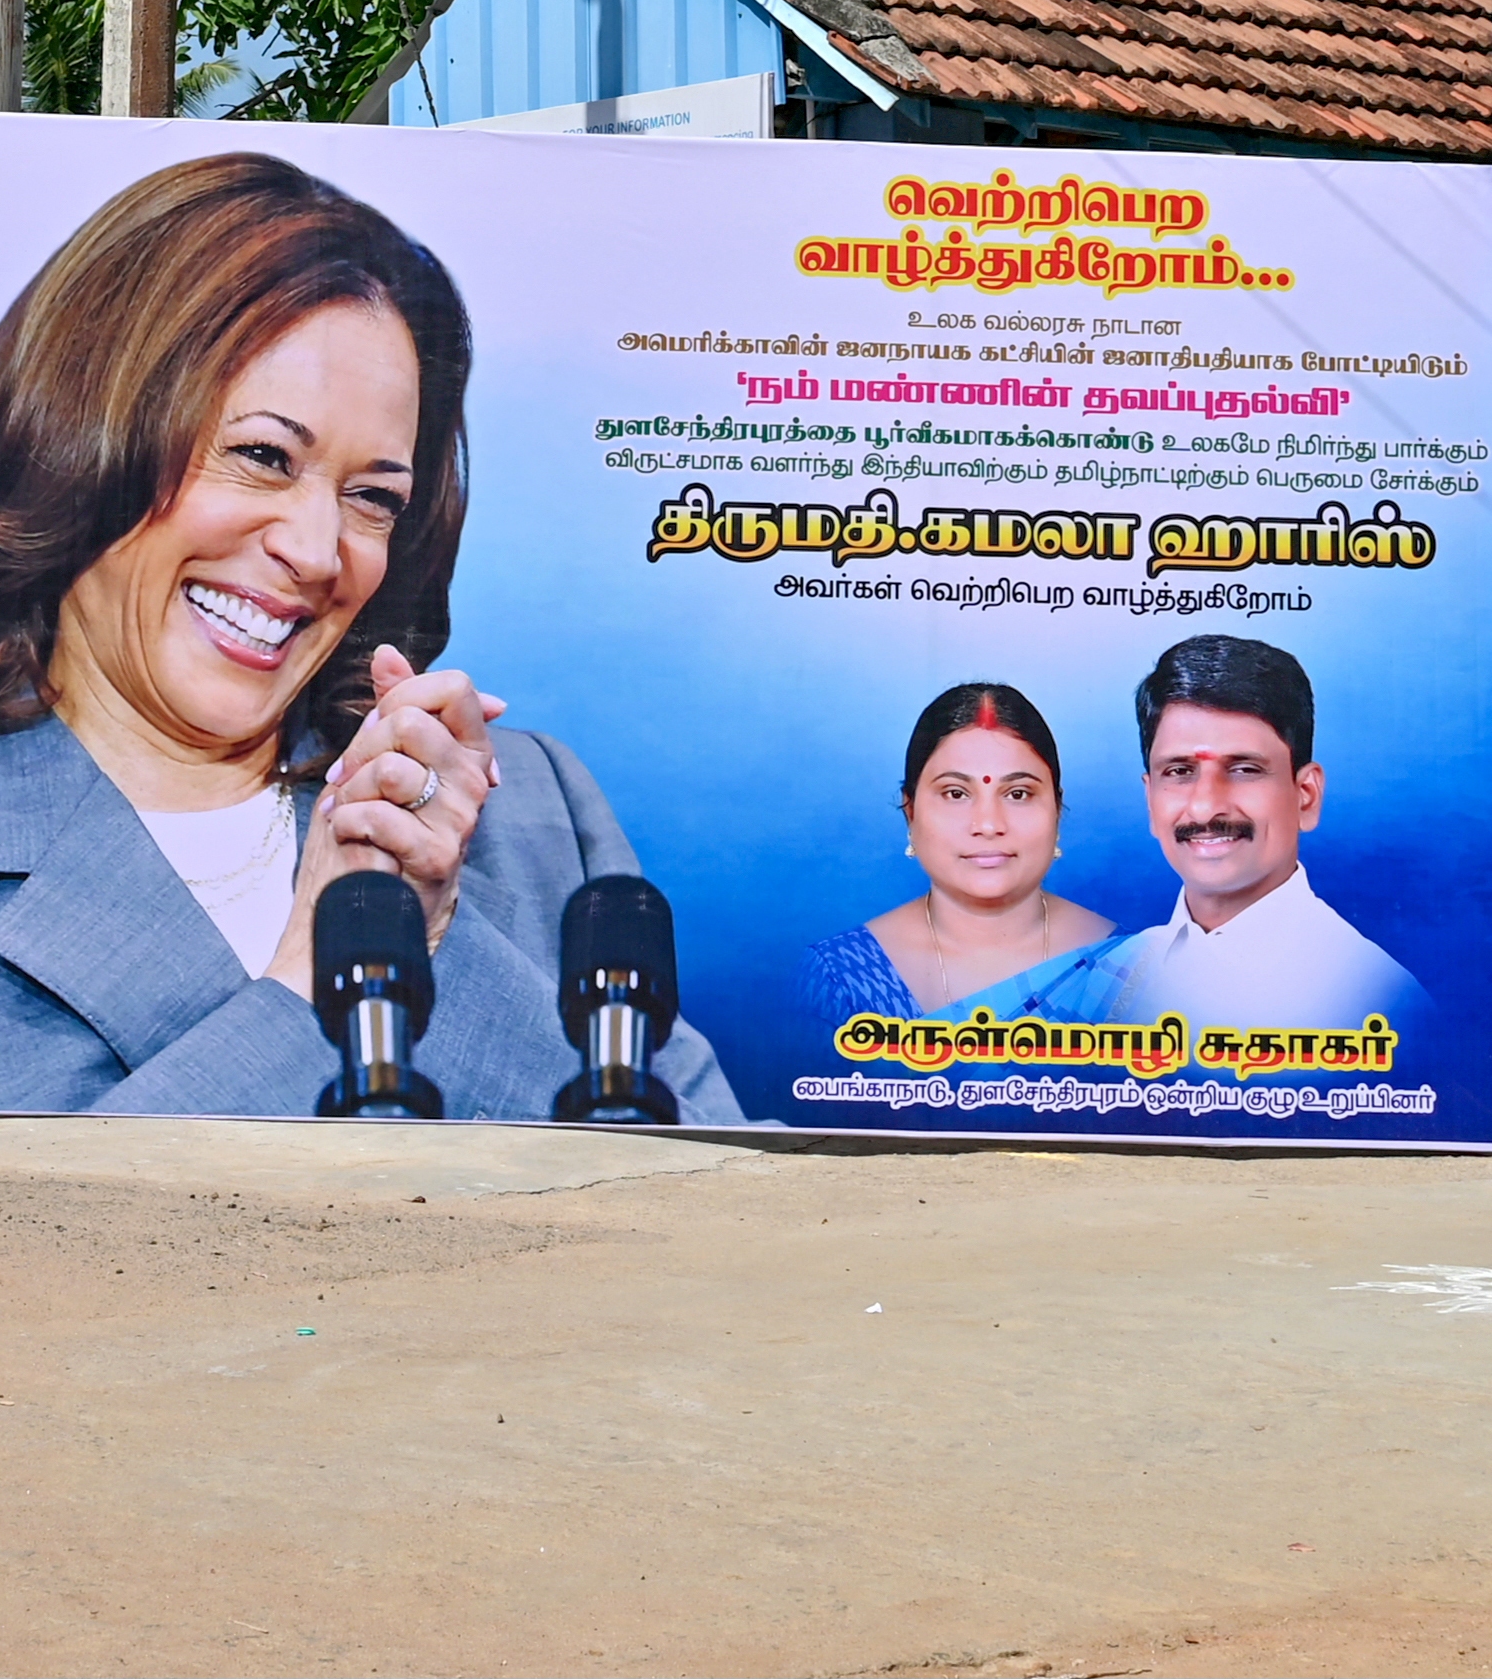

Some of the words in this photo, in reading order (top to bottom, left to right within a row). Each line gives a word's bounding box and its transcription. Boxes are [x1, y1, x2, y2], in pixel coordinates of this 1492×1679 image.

[617, 111, 691, 134] INFORMATION
[888, 172, 1205, 237] வெற்றிபெற
[799, 230, 1290, 296] வாழ்த்துகிறோம்...
[908, 311, 975, 330] உலக
[983, 311, 1085, 335] வல்லரசு
[1092, 317, 1182, 340] நாடான
[617, 330, 828, 357] அமெரிக்காவின்
[836, 339, 971, 364] ஜனநாயக
[979, 341, 1095, 364] கட்சியின்
[1102, 345, 1293, 372] ஜனாதிபதியாக
[1301, 353, 1468, 378] போட்டியிடும்
[830, 373, 1073, 408] மண்ணின்
[595, 414, 856, 443] துளசேந்திரபுரத்தை
[864, 419, 1154, 453] பூர்வீகமாகக்கொண்டு
[1162, 431, 1270, 454] உலகமே
[1277, 433, 1377, 462] நிமிர்ந்து
[1384, 436, 1488, 463] பார்க்கும்
[605, 448, 743, 474] விருட்சமாக
[751, 451, 853, 480] வளர்ந்து
[861, 453, 1047, 485] இந்தியாவிற்கும்
[1055, 460, 1249, 489] தமிழ்நாட்டிற்கும்
[1257, 468, 1363, 493] பெருமை
[1370, 469, 1479, 496] சேர்க்கும்
[1149, 501, 1434, 576] ஹாரிஸ்
[773, 573, 903, 601] அவர்கள்
[911, 577, 1074, 613] வெற்றிபெற
[1083, 581, 1312, 619] வாழ்த்துகிறோம்
[839, 1010, 1184, 1074] அருள்மொழி
[1198, 1017, 1393, 1075] சுதாகர்
[960, 1078, 1141, 1111] துளசேந்திரபுரம்
[1146, 1082, 1238, 1115] ஒன்றிய
[1245, 1088, 1296, 1118] குழு
[1302, 1085, 1436, 1118] உறுப்பினர்
